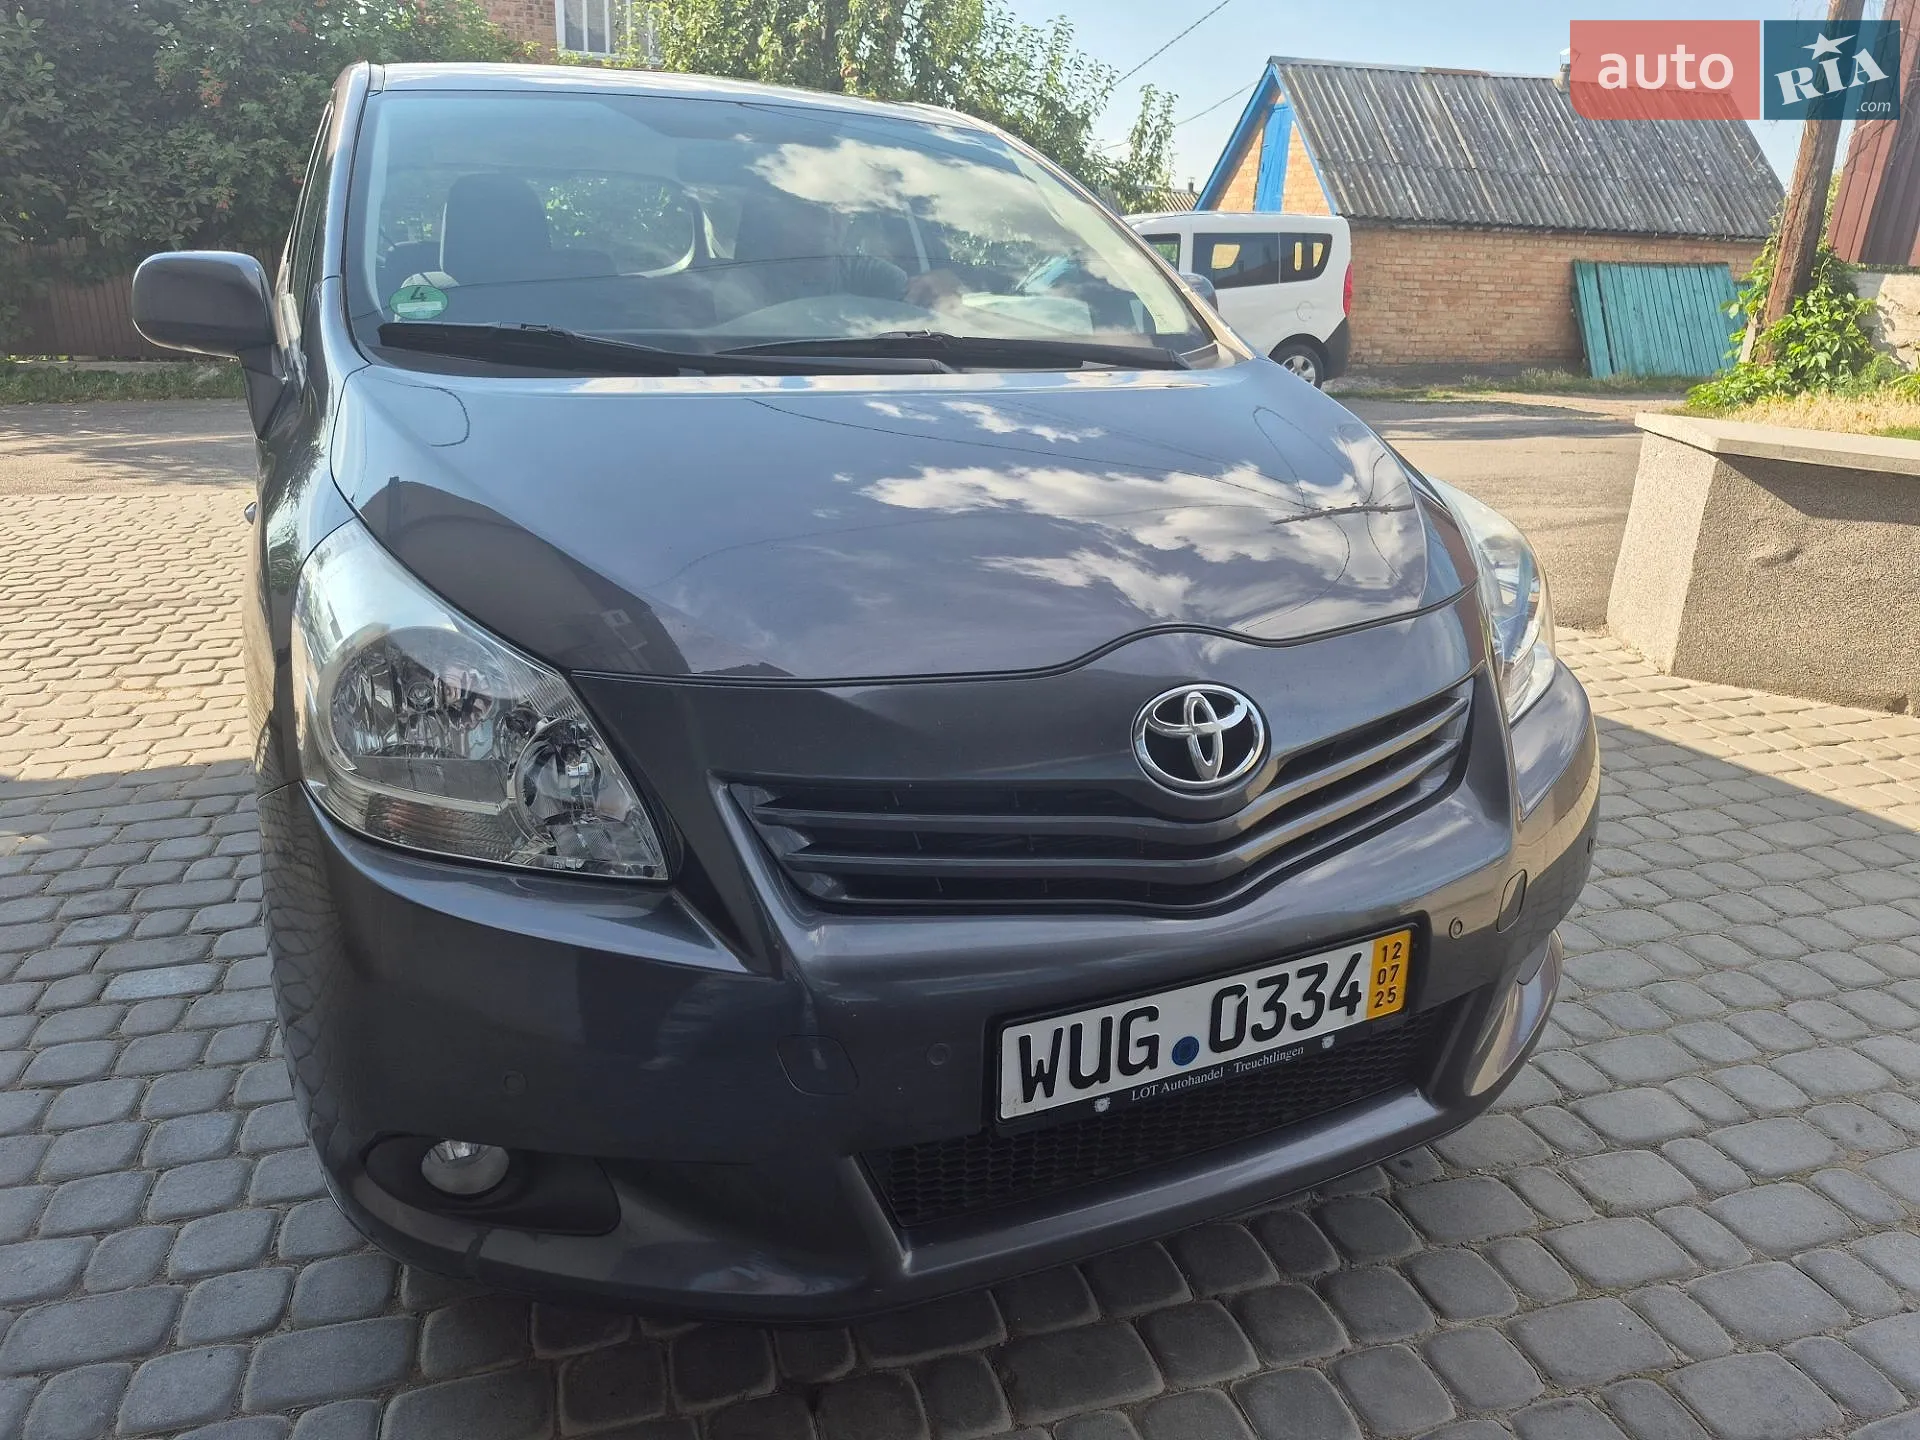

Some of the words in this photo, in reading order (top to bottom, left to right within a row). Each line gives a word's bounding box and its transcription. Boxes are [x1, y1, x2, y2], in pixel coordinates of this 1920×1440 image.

[410, 286, 427, 301] 4
[1382, 941, 1402, 963] 12
[1377, 963, 1400, 986] 07
[1373, 986, 1397, 1009] 25
[1018, 1005, 1160, 1103] WUG
[1208, 952, 1363, 1054] 0334
[1131, 1084, 1159, 1102] LOT
[1161, 1067, 1224, 1094] Autohandel
[1233, 1046, 1304, 1073] Treuchtlingen
